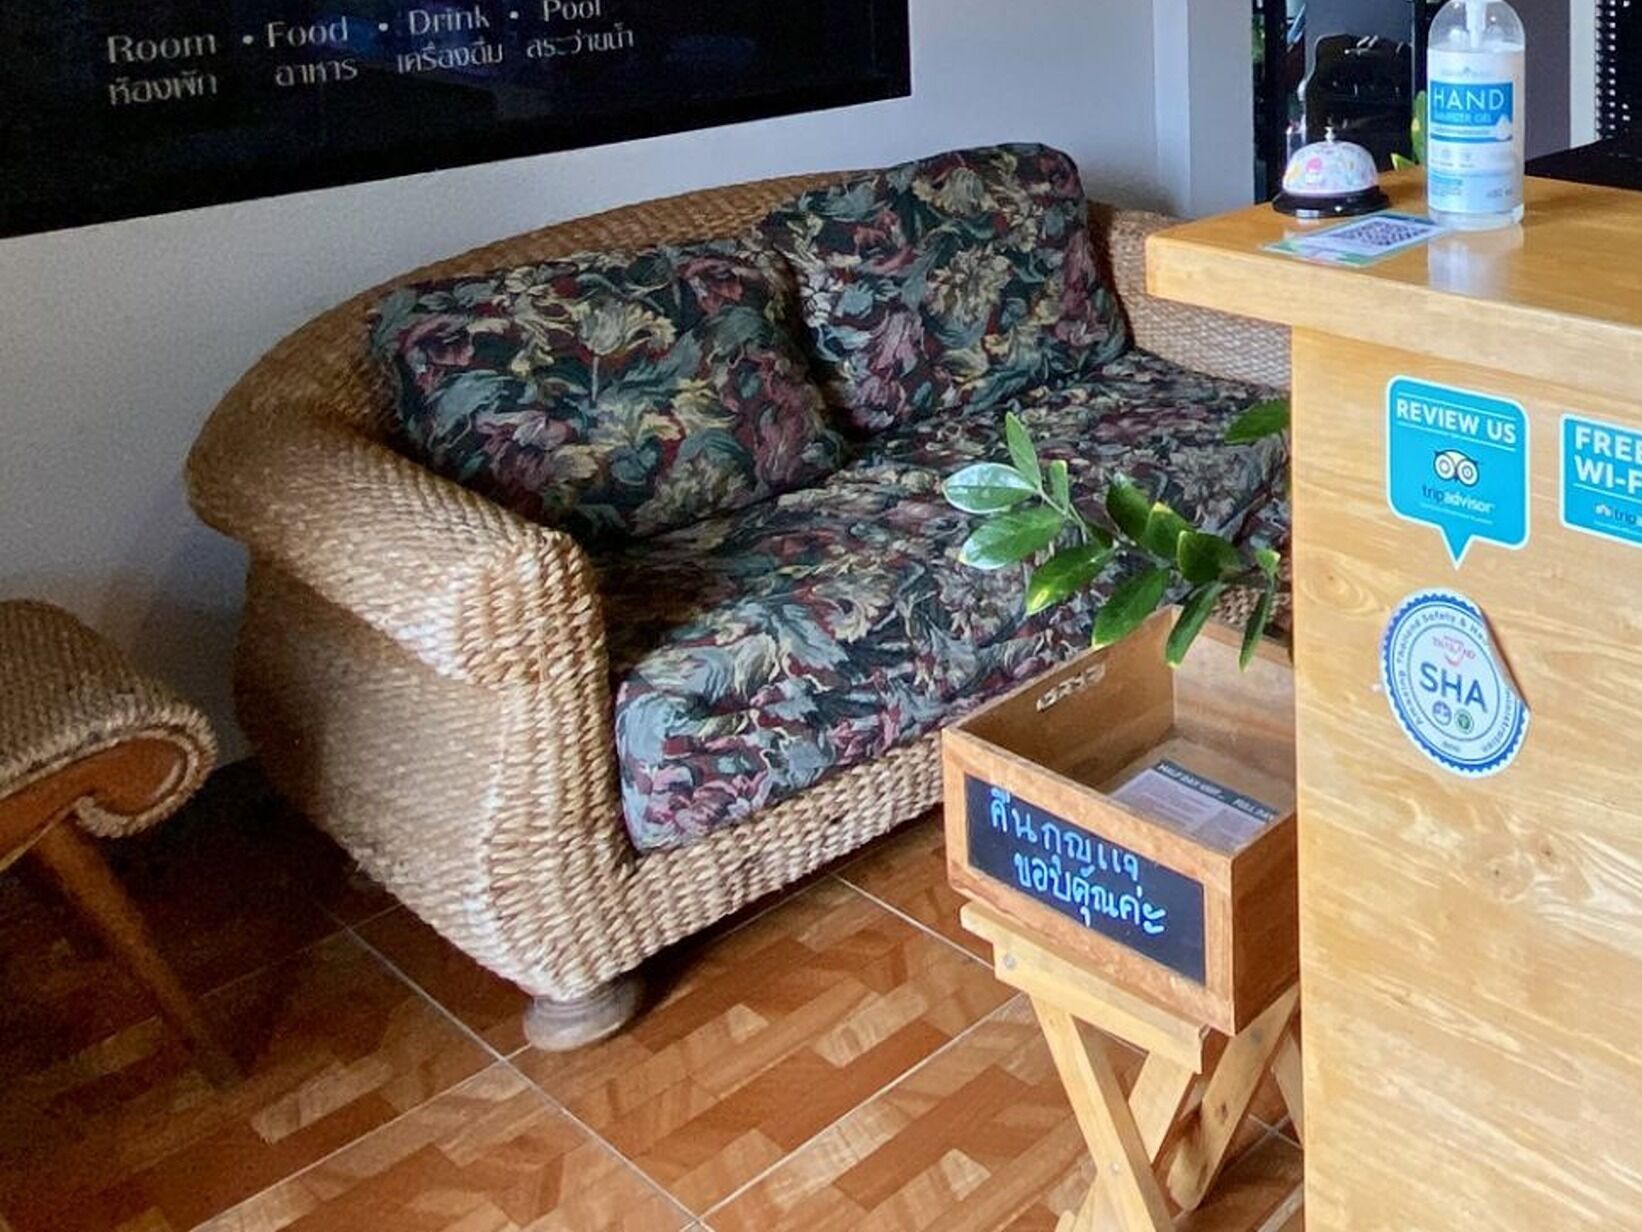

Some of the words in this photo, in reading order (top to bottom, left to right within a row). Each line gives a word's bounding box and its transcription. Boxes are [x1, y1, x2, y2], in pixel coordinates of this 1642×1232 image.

[107, 32, 217, 65] Room
[267, 16, 349, 49] Food
[408, 4, 491, 36] Drink
[276, 54, 358, 87] อาหาร
[1434, 88, 1504, 110] HAND
[1396, 397, 1480, 435] REVIEW
[1487, 419, 1517, 445] US
[1422, 484, 1494, 514] tripadvisor
[1419, 661, 1488, 715] SHA
